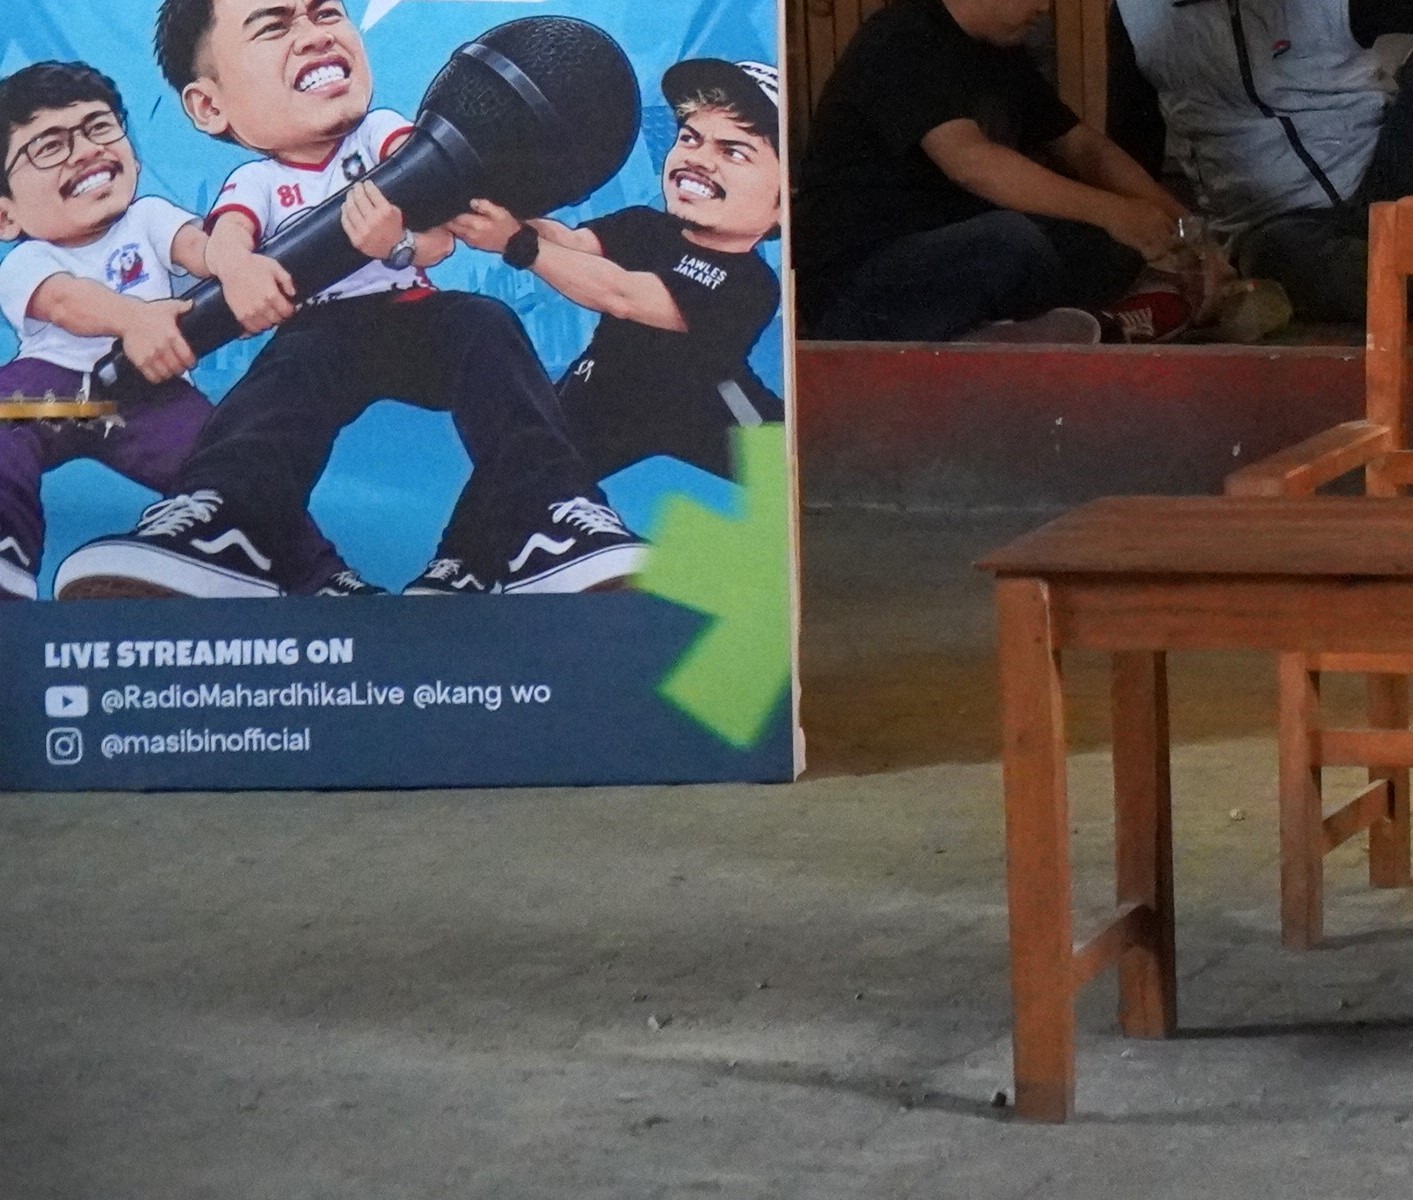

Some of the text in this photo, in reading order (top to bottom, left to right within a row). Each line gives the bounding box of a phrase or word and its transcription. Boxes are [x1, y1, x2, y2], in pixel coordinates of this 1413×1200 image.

[276, 182, 305, 209] 81
[673, 263, 722, 291] JAKART
[679, 253, 728, 282] LAWLES
[44, 637, 354, 668] LIVE STREAMING ON
[101, 680, 551, 714] @RadioMahardhikaLive @kang wo
[100, 727, 310, 759] @masibinofficial
